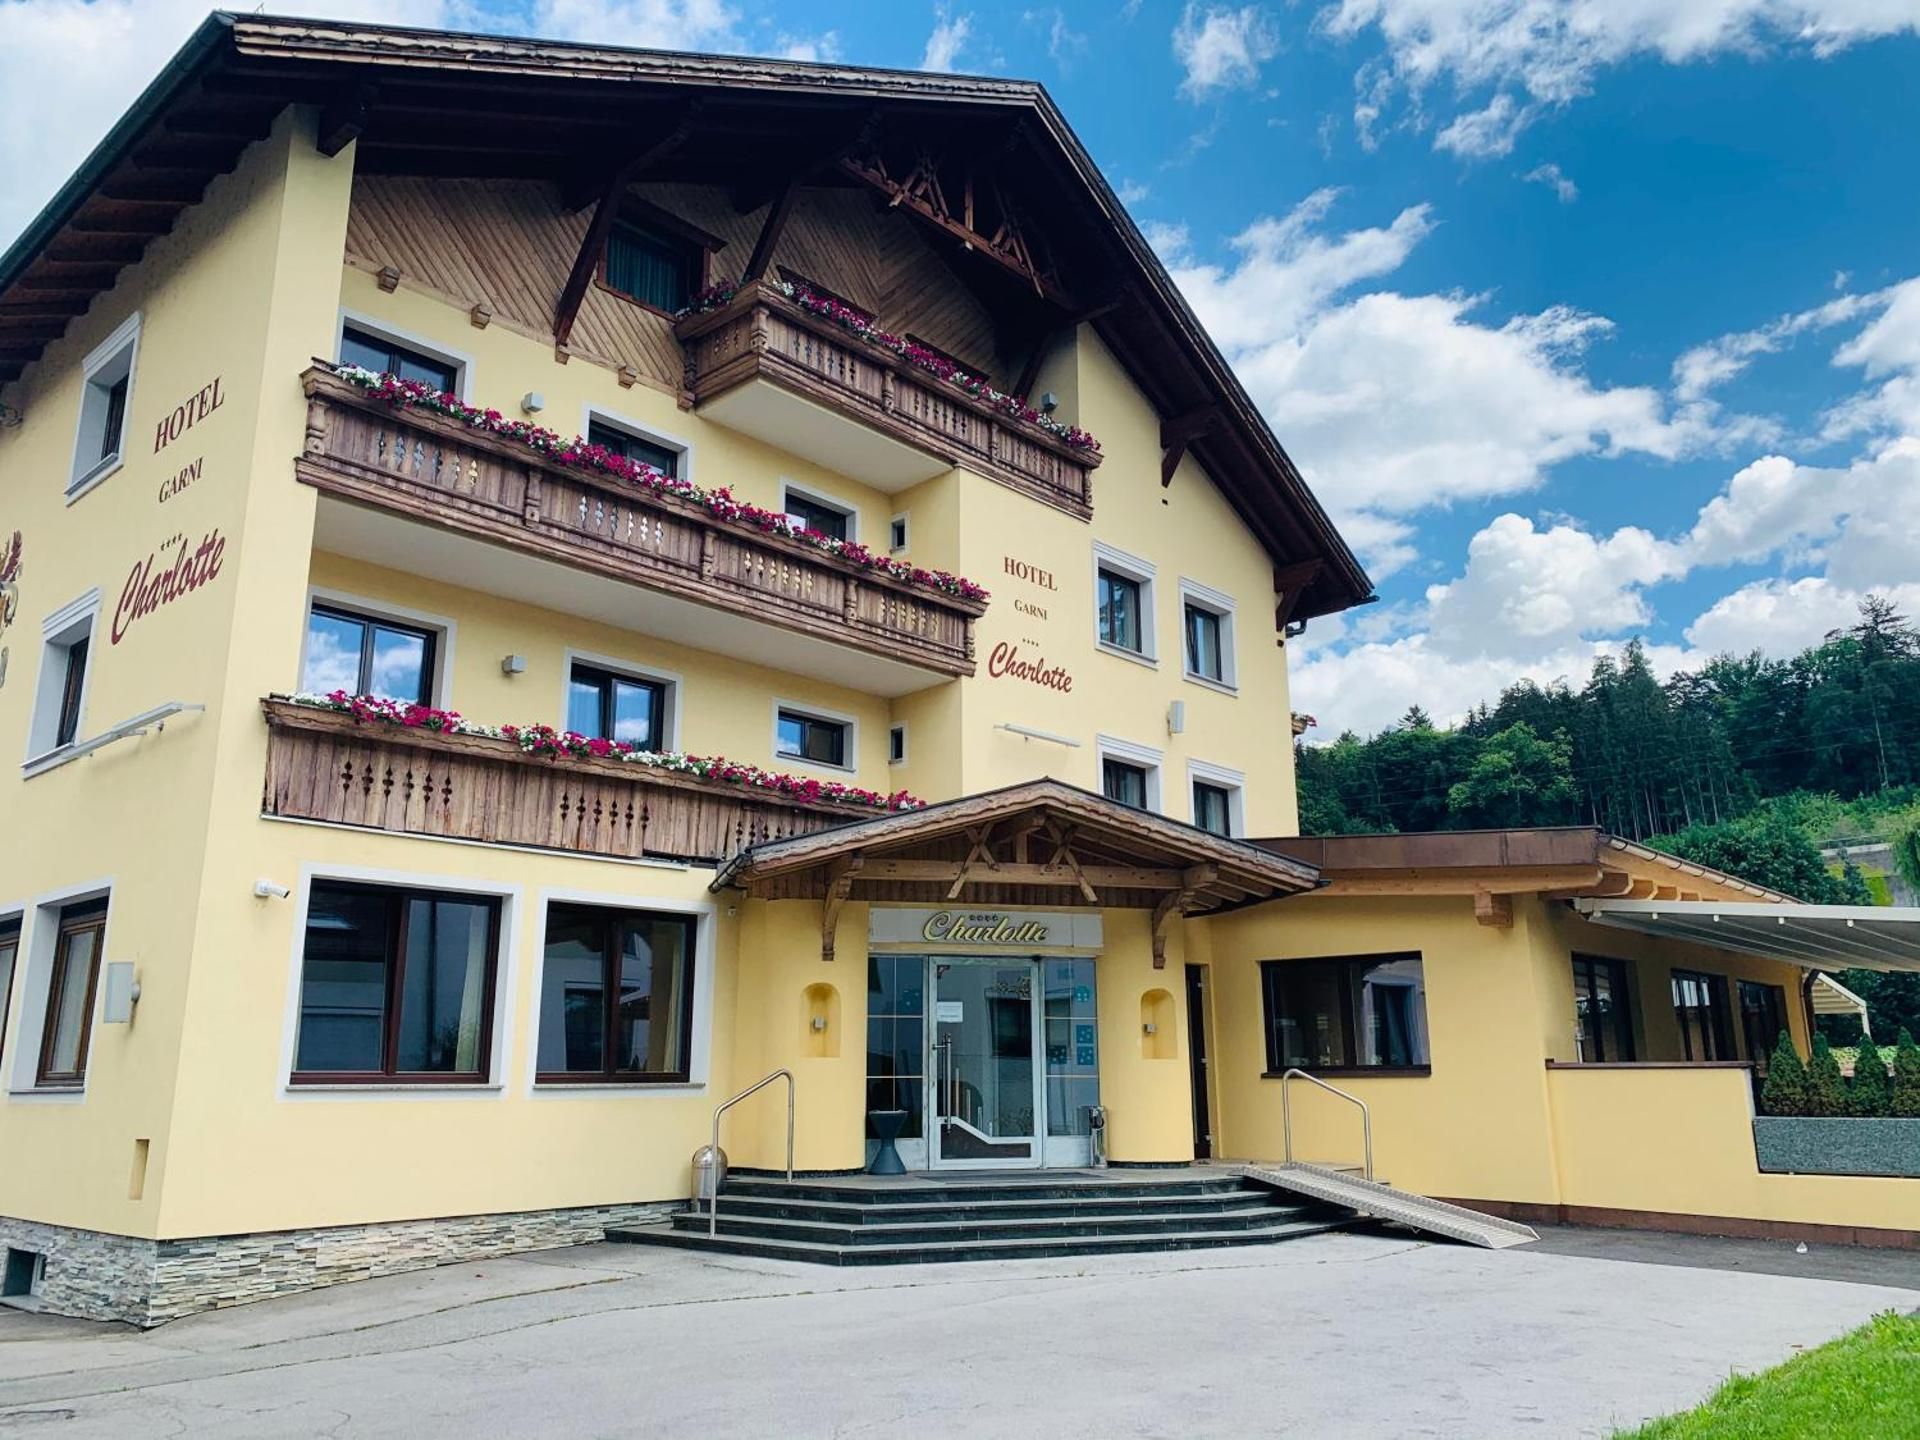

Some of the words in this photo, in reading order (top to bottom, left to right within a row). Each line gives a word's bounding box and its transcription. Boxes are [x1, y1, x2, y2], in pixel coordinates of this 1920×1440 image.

[153, 376, 225, 454] HOTEL
[158, 457, 204, 503] GARNI
[111, 528, 226, 645] Charlotte
[1004, 556, 1058, 592] HOTEL
[1014, 599, 1048, 620] GARNI
[988, 642, 1073, 693] Charlotte
[922, 911, 1048, 943] Charlotte
